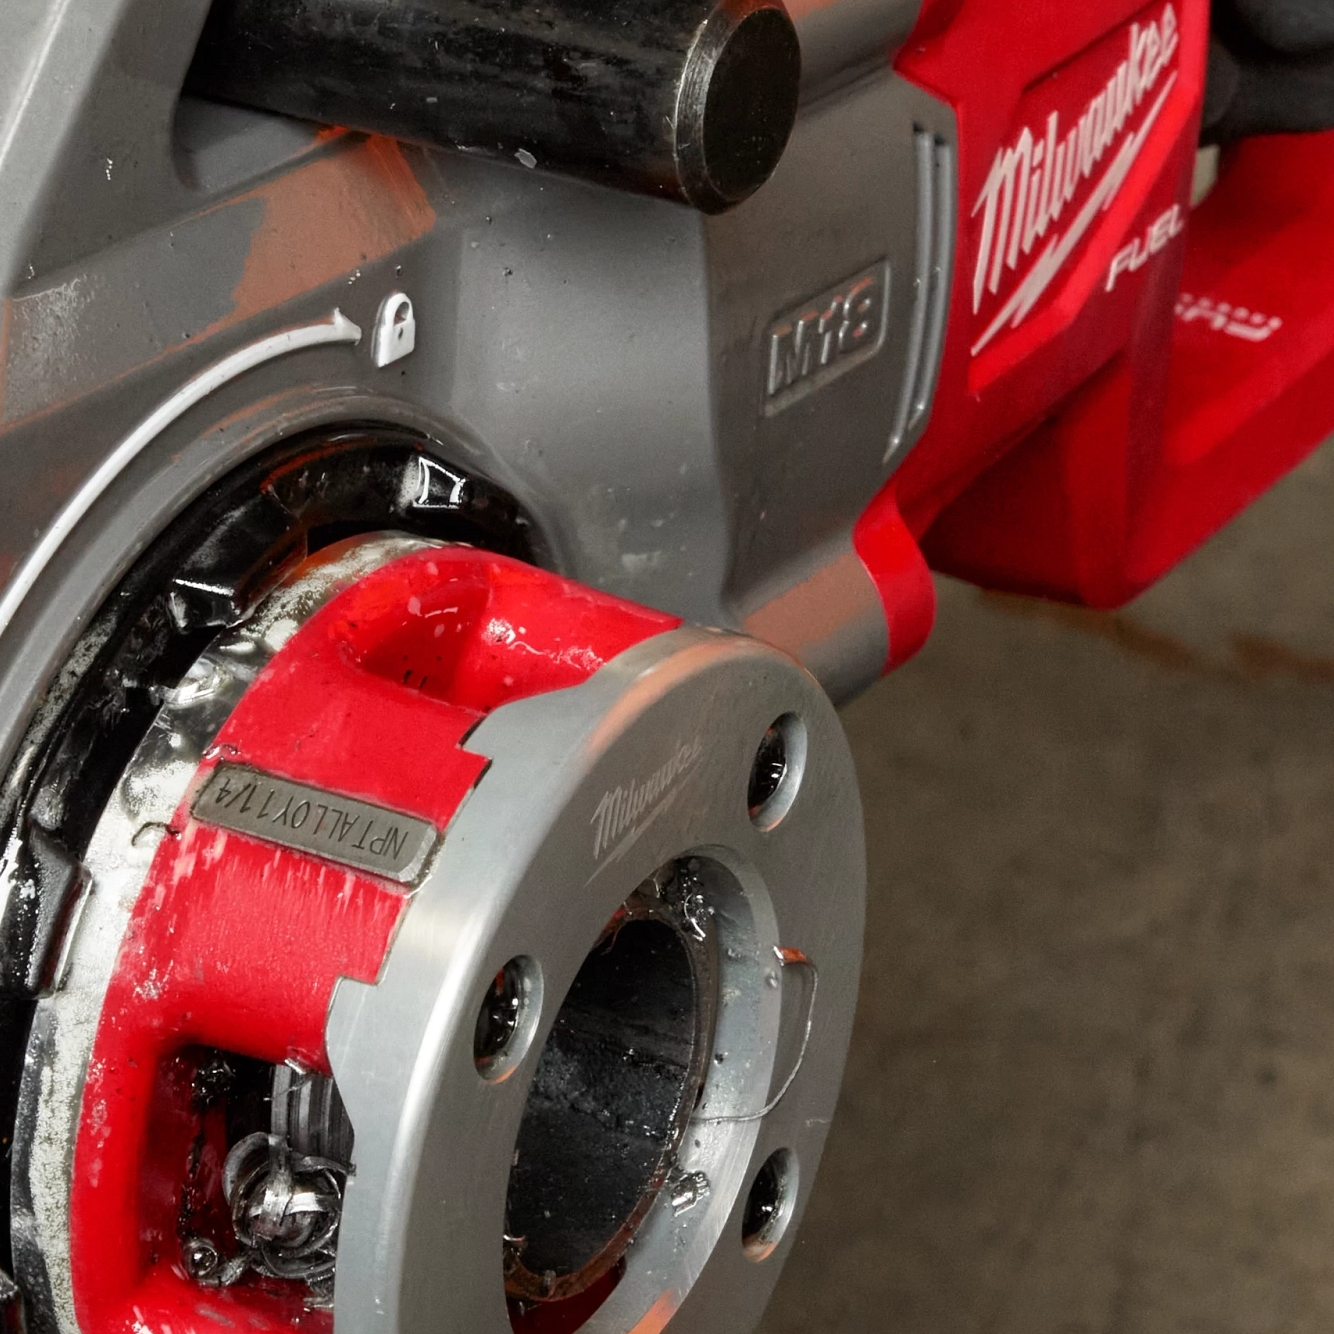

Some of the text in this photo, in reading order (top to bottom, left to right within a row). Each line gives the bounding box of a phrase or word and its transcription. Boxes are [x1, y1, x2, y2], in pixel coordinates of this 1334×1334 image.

[971, 3, 1179, 316] Milwaukee
[1105, 204, 1185, 292] FUEL
[768, 276, 874, 395] M18
[272, 795, 361, 843] ALLOY
[351, 820, 409, 861] NPT
[589, 734, 704, 861] Milwaukee
